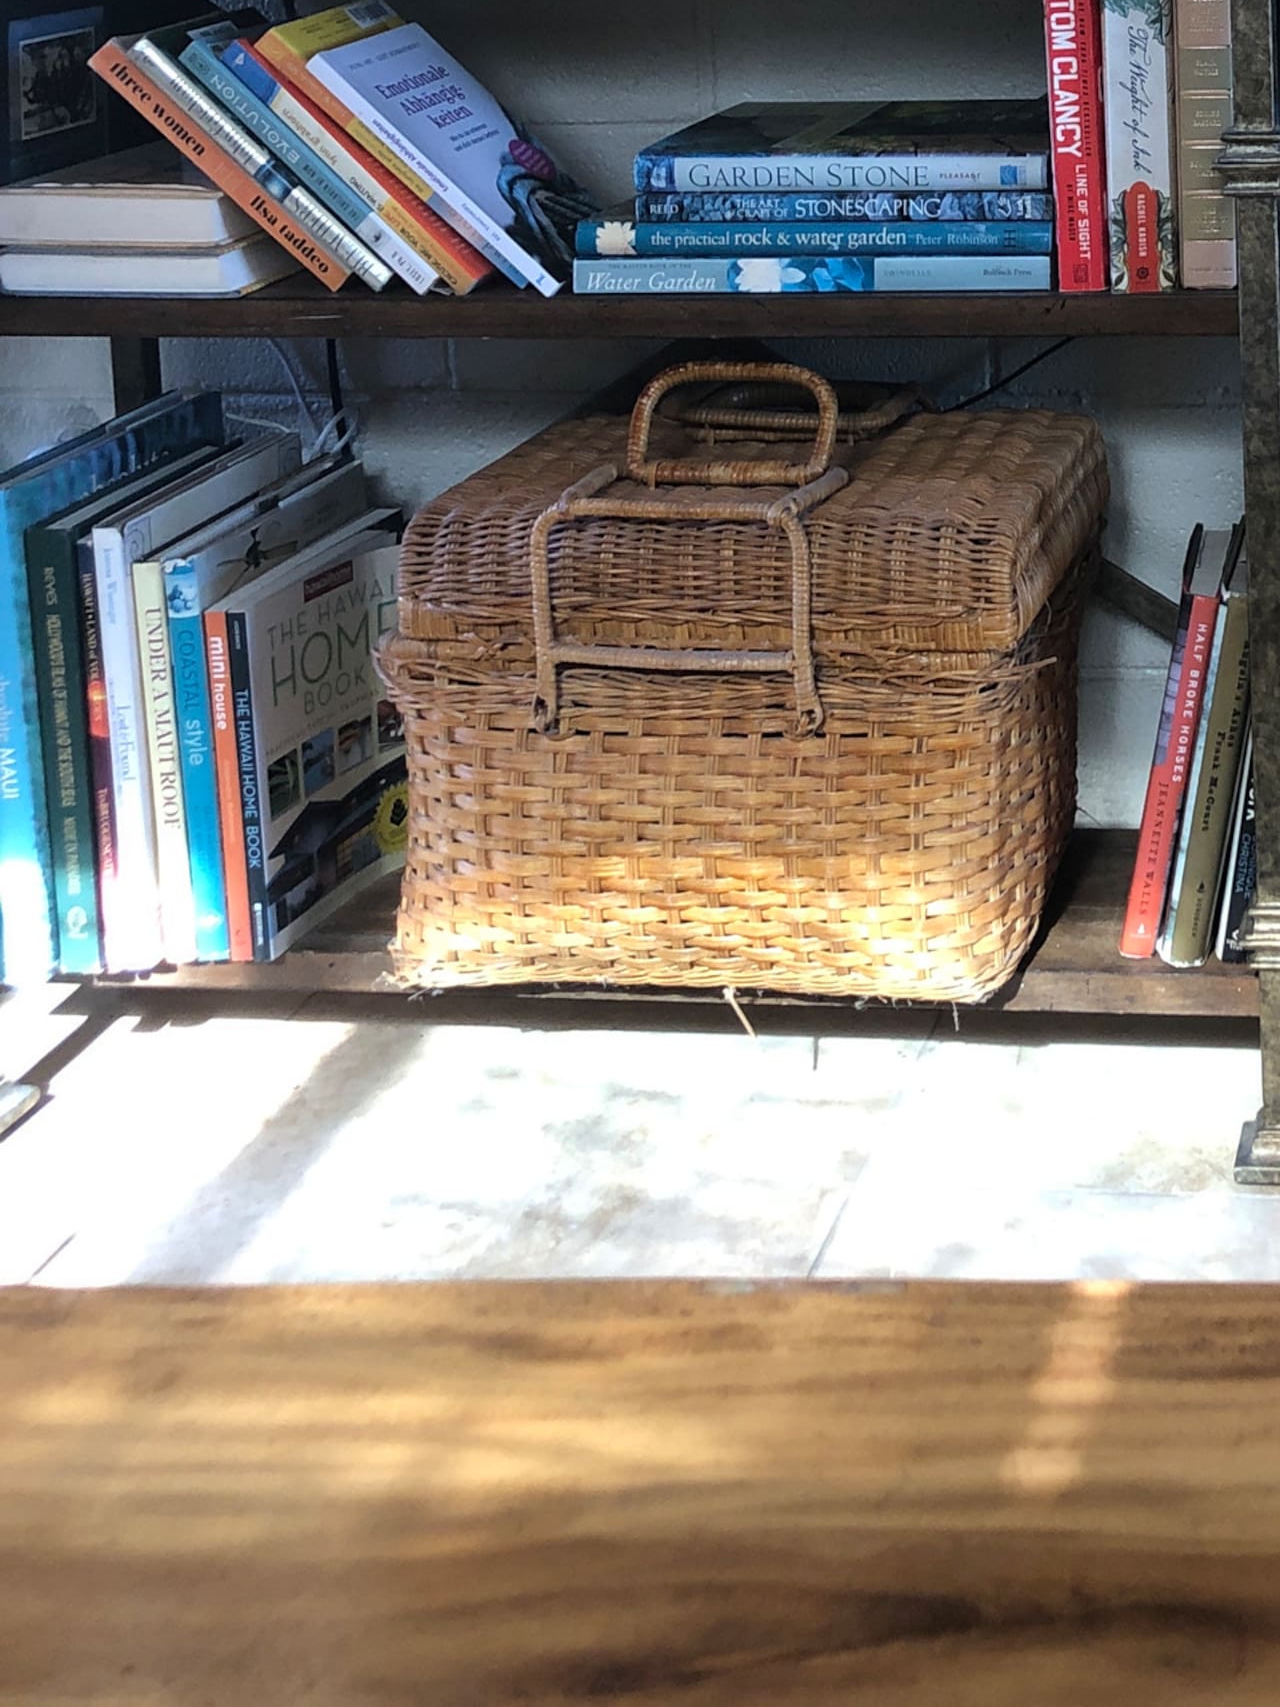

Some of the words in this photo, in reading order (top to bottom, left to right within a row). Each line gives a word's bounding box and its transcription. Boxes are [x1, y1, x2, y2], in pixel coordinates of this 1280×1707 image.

[1127, 25, 1152, 66] The
[374, 64, 451, 100] Emotionale
[1119, 60, 1153, 122] Weight
[109, 62, 152, 103] three
[152, 102, 206, 157] women
[210, 74, 300, 165] EVOLUTION
[427, 105, 474, 130] keiten
[1052, 55, 1082, 158] CLANCY
[688, 163, 816, 188] GARDEN
[826, 163, 930, 187] STONE
[1131, 139, 1153, 175] Ink
[1075, 163, 1088, 197] LINE
[650, 203, 680, 215] REED
[794, 197, 942, 219] STONESCAPING
[1078, 200, 1089, 215] OF
[250, 195, 278, 227] lisa
[278, 224, 329, 274] taddeo
[651, 231, 672, 246] the
[674, 231, 731, 249] practical
[734, 227, 773, 246] rock
[776, 234, 791, 246] &
[794, 231, 844, 246] water
[847, 226, 907, 249] garden
[915, 233, 942, 246] Peter
[946, 232, 999, 246] Robinson
[1078, 219, 1091, 261] SIGHT
[587, 271, 642, 290] Water
[648, 269, 716, 290] Garden
[43, 566, 59, 605] REYES
[145, 607, 168, 682] UNDER
[267, 611, 308, 650] THE
[1192, 623, 1209, 663] HALF
[178, 629, 200, 711] COASTAL
[209, 636, 226, 680] mini
[152, 688, 165, 703] A
[210, 685, 227, 730] house
[234, 688, 250, 715] THE
[303, 665, 367, 716] BOOK
[1182, 669, 1201, 719] BROKE
[154, 708, 176, 761] MAUI
[184, 719, 208, 766] style
[237, 719, 255, 773] HAWAII
[1171, 725, 1191, 783] HORSES
[1211, 731, 1226, 771] Frank
[0, 746, 20, 800] MAUI
[160, 770, 181, 829] ROOF
[241, 773, 258, 819] HOME
[1147, 781, 1169, 866] JEANNETTE
[246, 826, 262, 869] BOOK
[1234, 832, 1251, 894] CHRISTINA
[1138, 871, 1156, 916] WALLS
